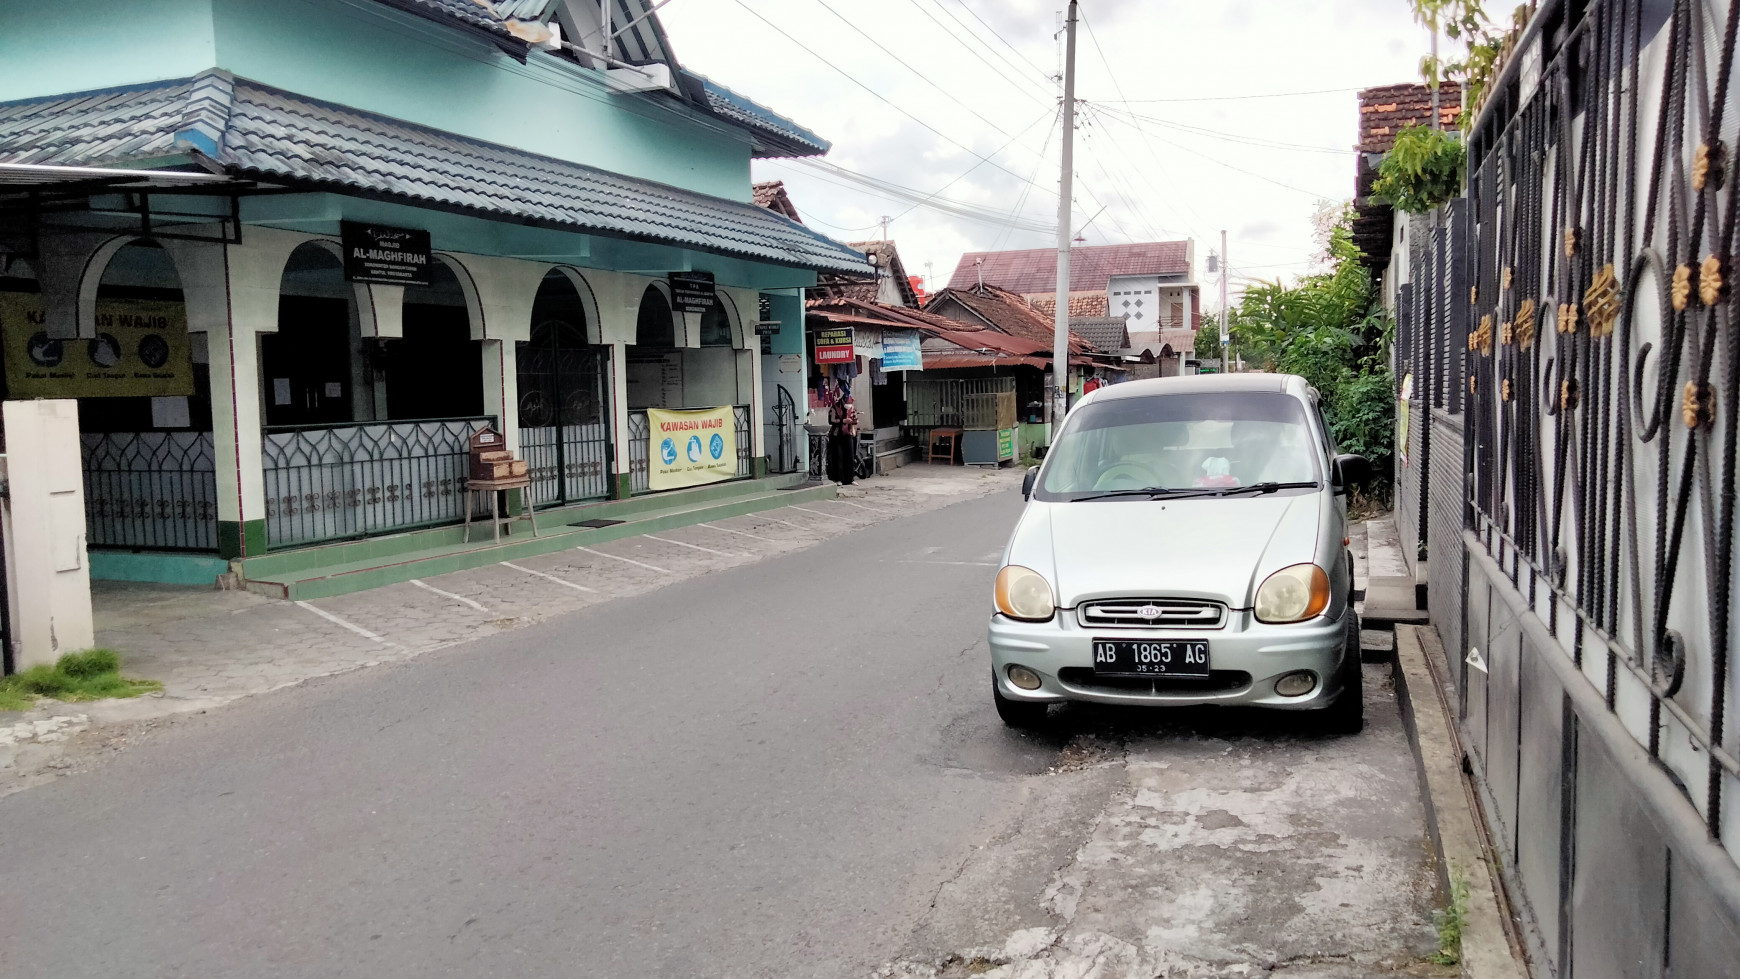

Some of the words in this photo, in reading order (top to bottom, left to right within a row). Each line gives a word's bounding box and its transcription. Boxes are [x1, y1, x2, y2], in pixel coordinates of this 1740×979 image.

[354, 247, 426, 264] AL-MAGHFIRAH
[120, 313, 168, 330] WAJIB
[816, 337, 830, 345] SOFA
[821, 330, 846, 338] REPARASI
[819, 349, 850, 360] LAUNDRY
[660, 420, 699, 432] KAWASAN
[701, 418, 723, 429] WAJIB
[1096, 643, 1116, 663] AB
[1132, 643, 1171, 663] 1865
[1185, 644, 1205, 664] AG
